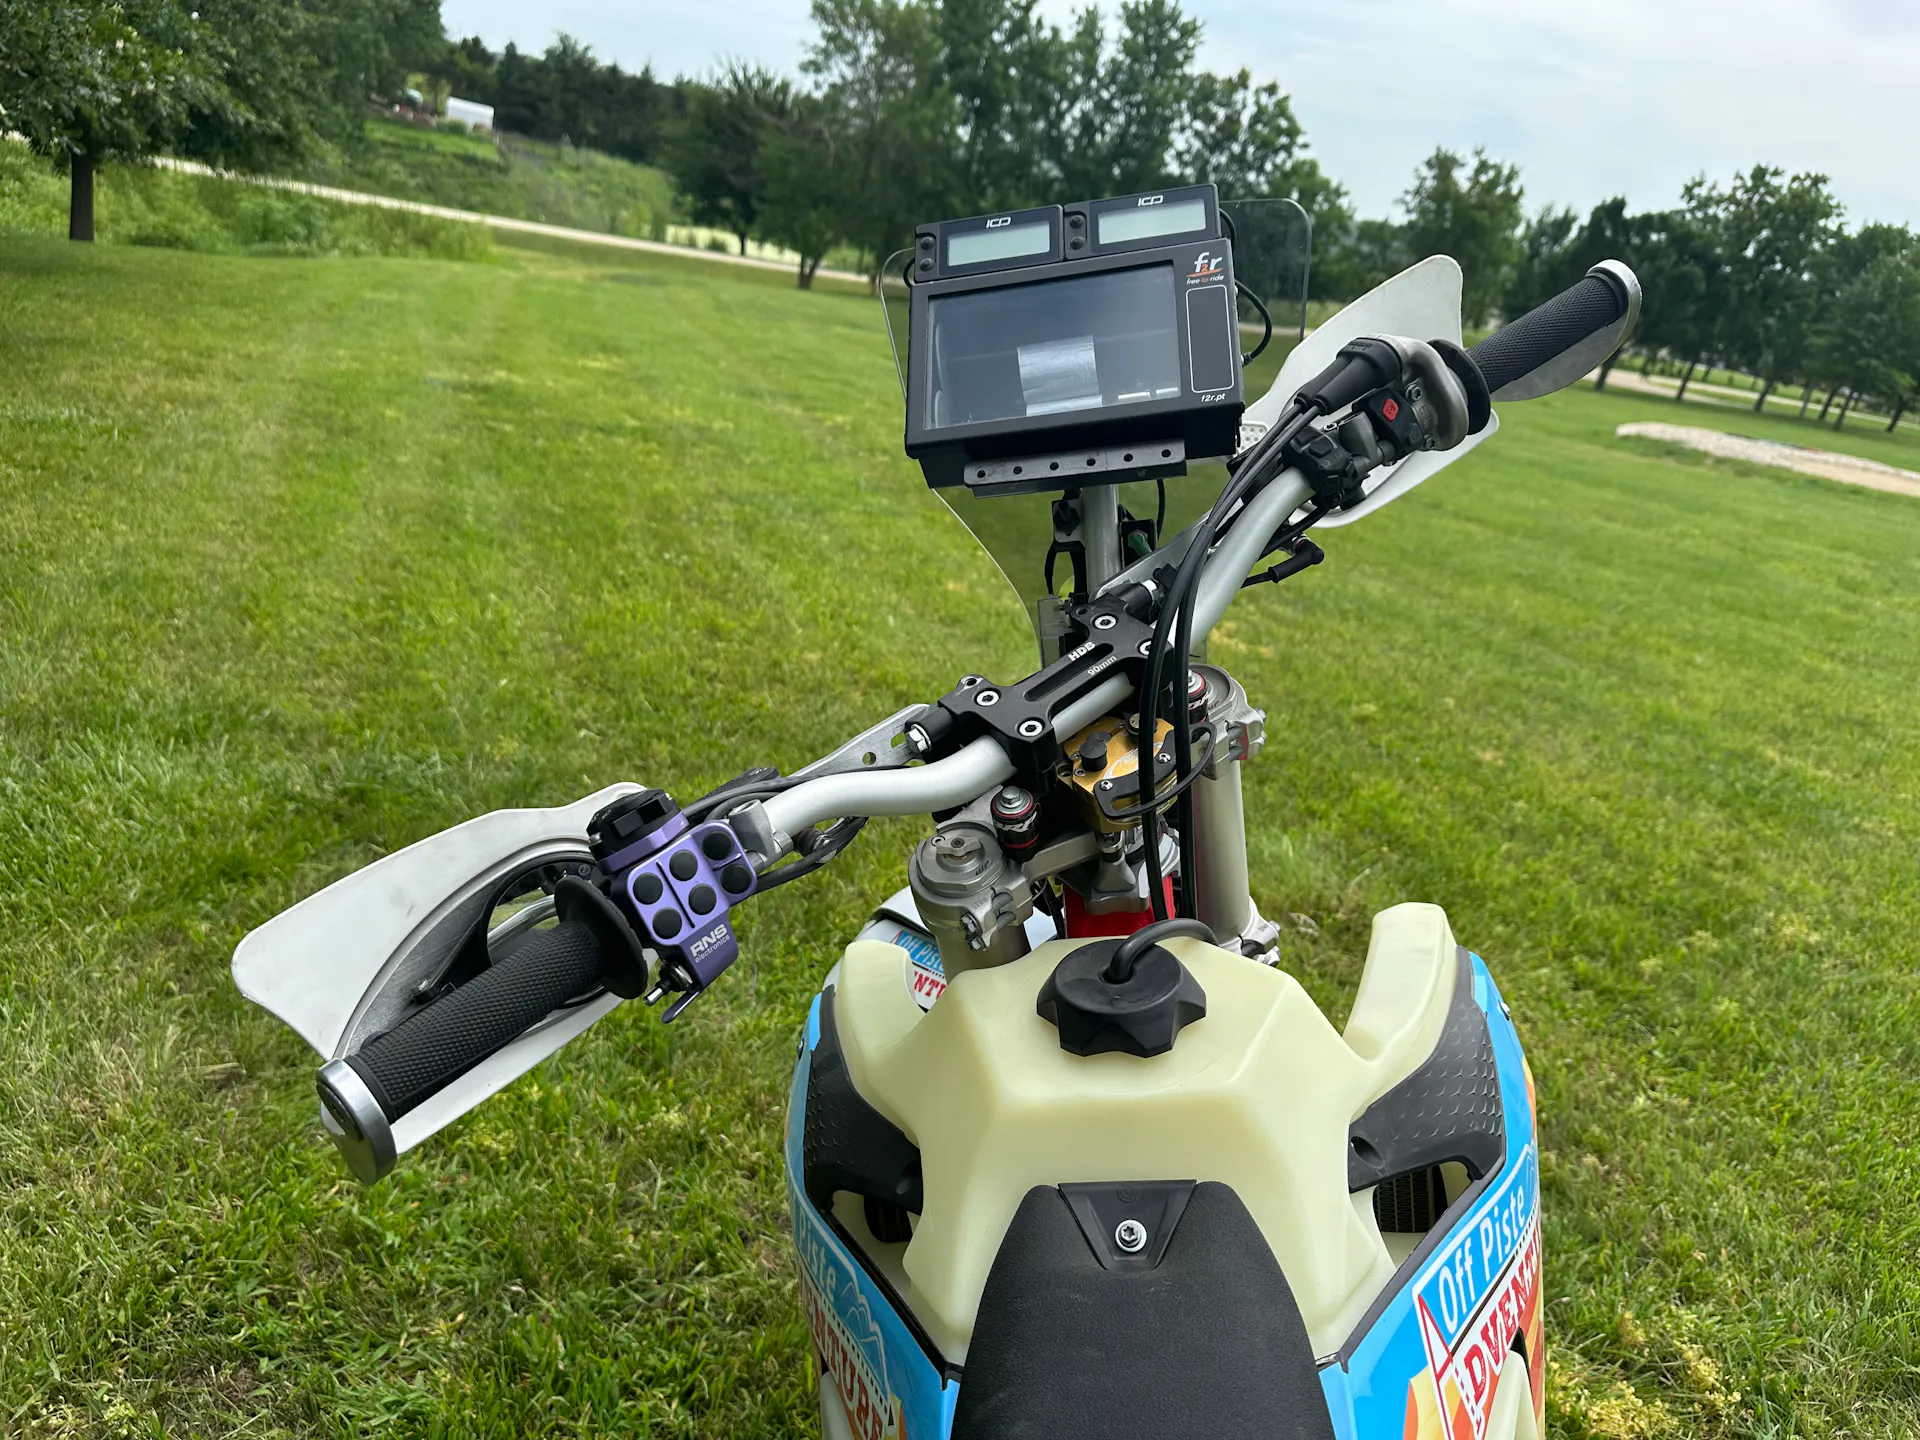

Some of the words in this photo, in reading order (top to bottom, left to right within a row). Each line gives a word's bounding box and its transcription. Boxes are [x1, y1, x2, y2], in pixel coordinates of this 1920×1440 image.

[1137, 194, 1164, 207] ICO
[985, 216, 1012, 229] ICO
[1209, 274, 1225, 282] ride
[1067, 641, 1096, 662] HDB
[1087, 655, 1117, 676] 90mm
[690, 923, 728, 957] RNS
[694, 934, 731, 964] electronics
[1438, 1237, 1476, 1334] Off
[1479, 1185, 1526, 1282] Piste
